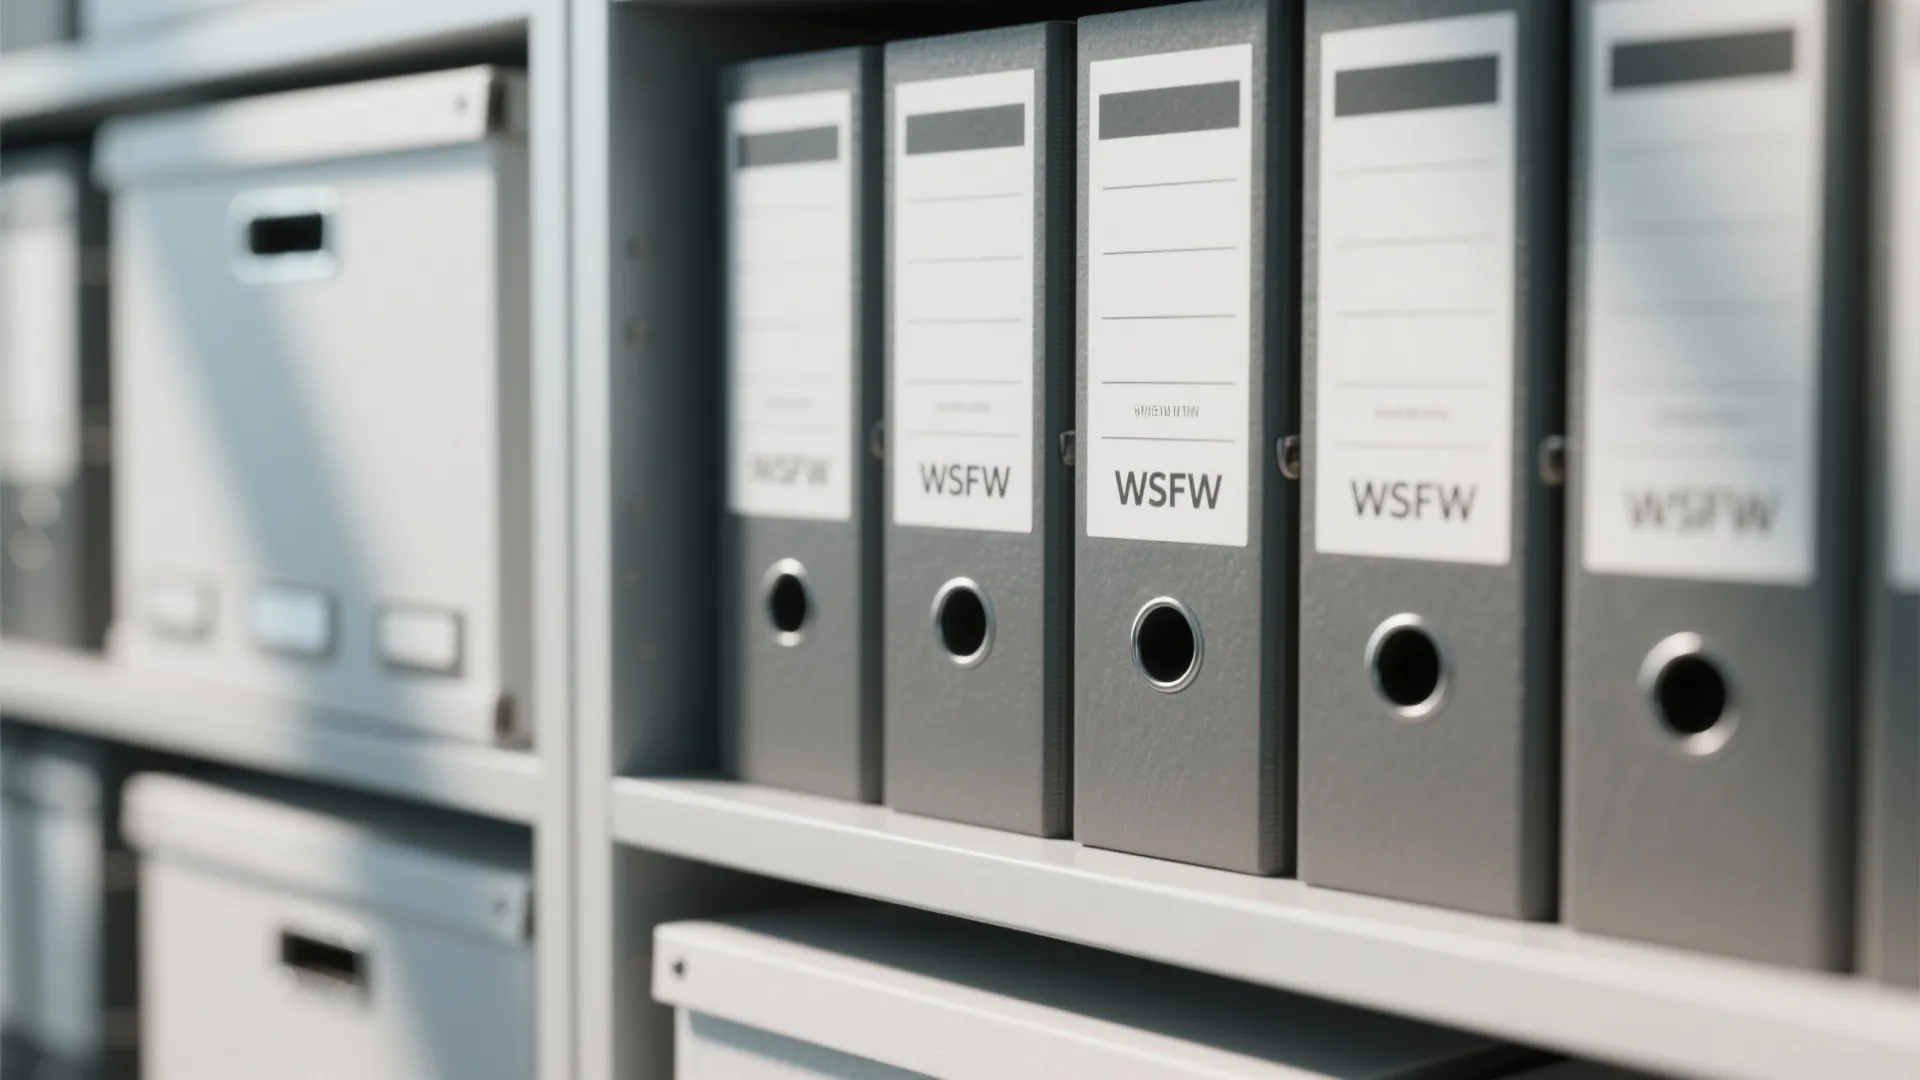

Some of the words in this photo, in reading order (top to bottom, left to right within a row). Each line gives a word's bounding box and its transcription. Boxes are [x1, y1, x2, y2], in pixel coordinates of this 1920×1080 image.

[920, 463, 1010, 498] WSFW
[1114, 469, 1222, 509] WSFW
[1351, 480, 1476, 521] WSFW
